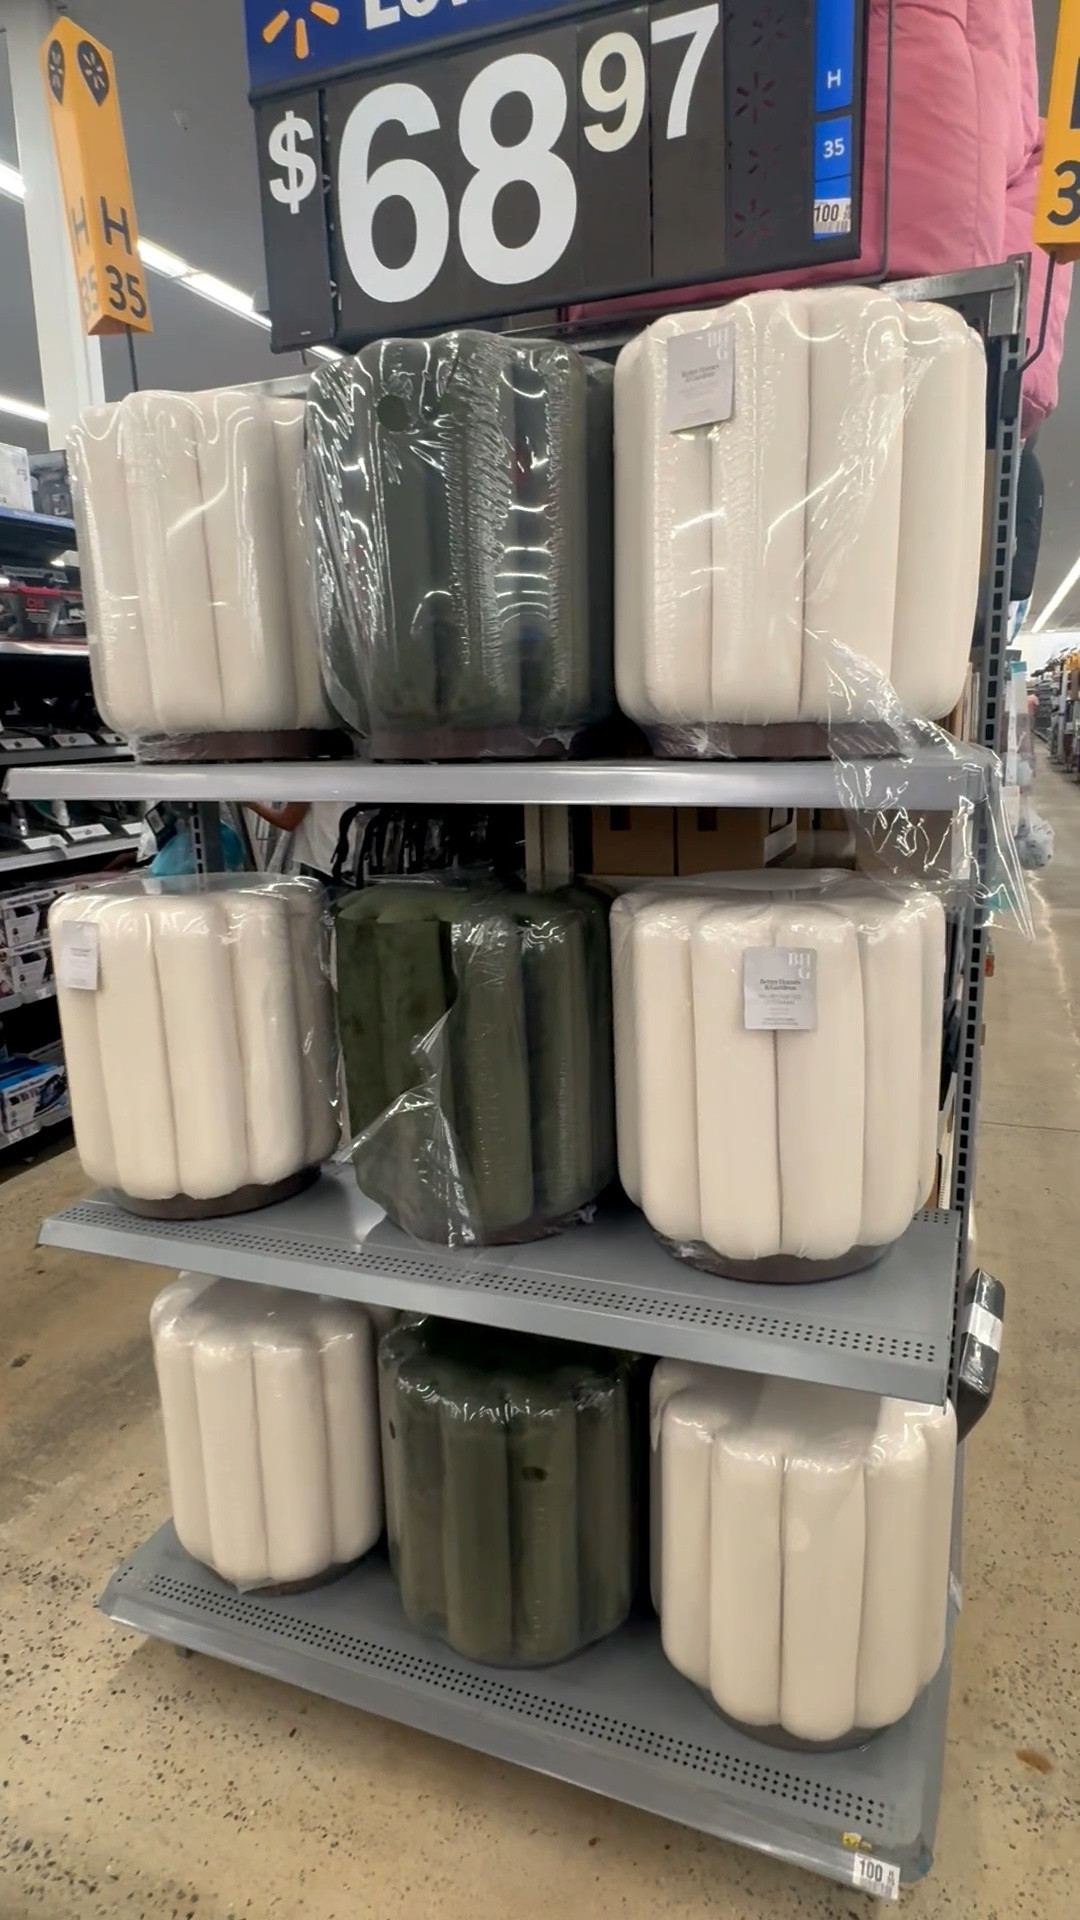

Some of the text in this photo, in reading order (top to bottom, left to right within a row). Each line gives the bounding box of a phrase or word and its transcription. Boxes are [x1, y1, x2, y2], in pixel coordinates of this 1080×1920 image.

[827, 68, 842, 89] H
[823, 137, 845, 159] 35
[814, 203, 839, 223] 100
[101, 195, 132, 256] H
[105, 264, 147, 319] 35
[859, 1859, 883, 1882] 100
